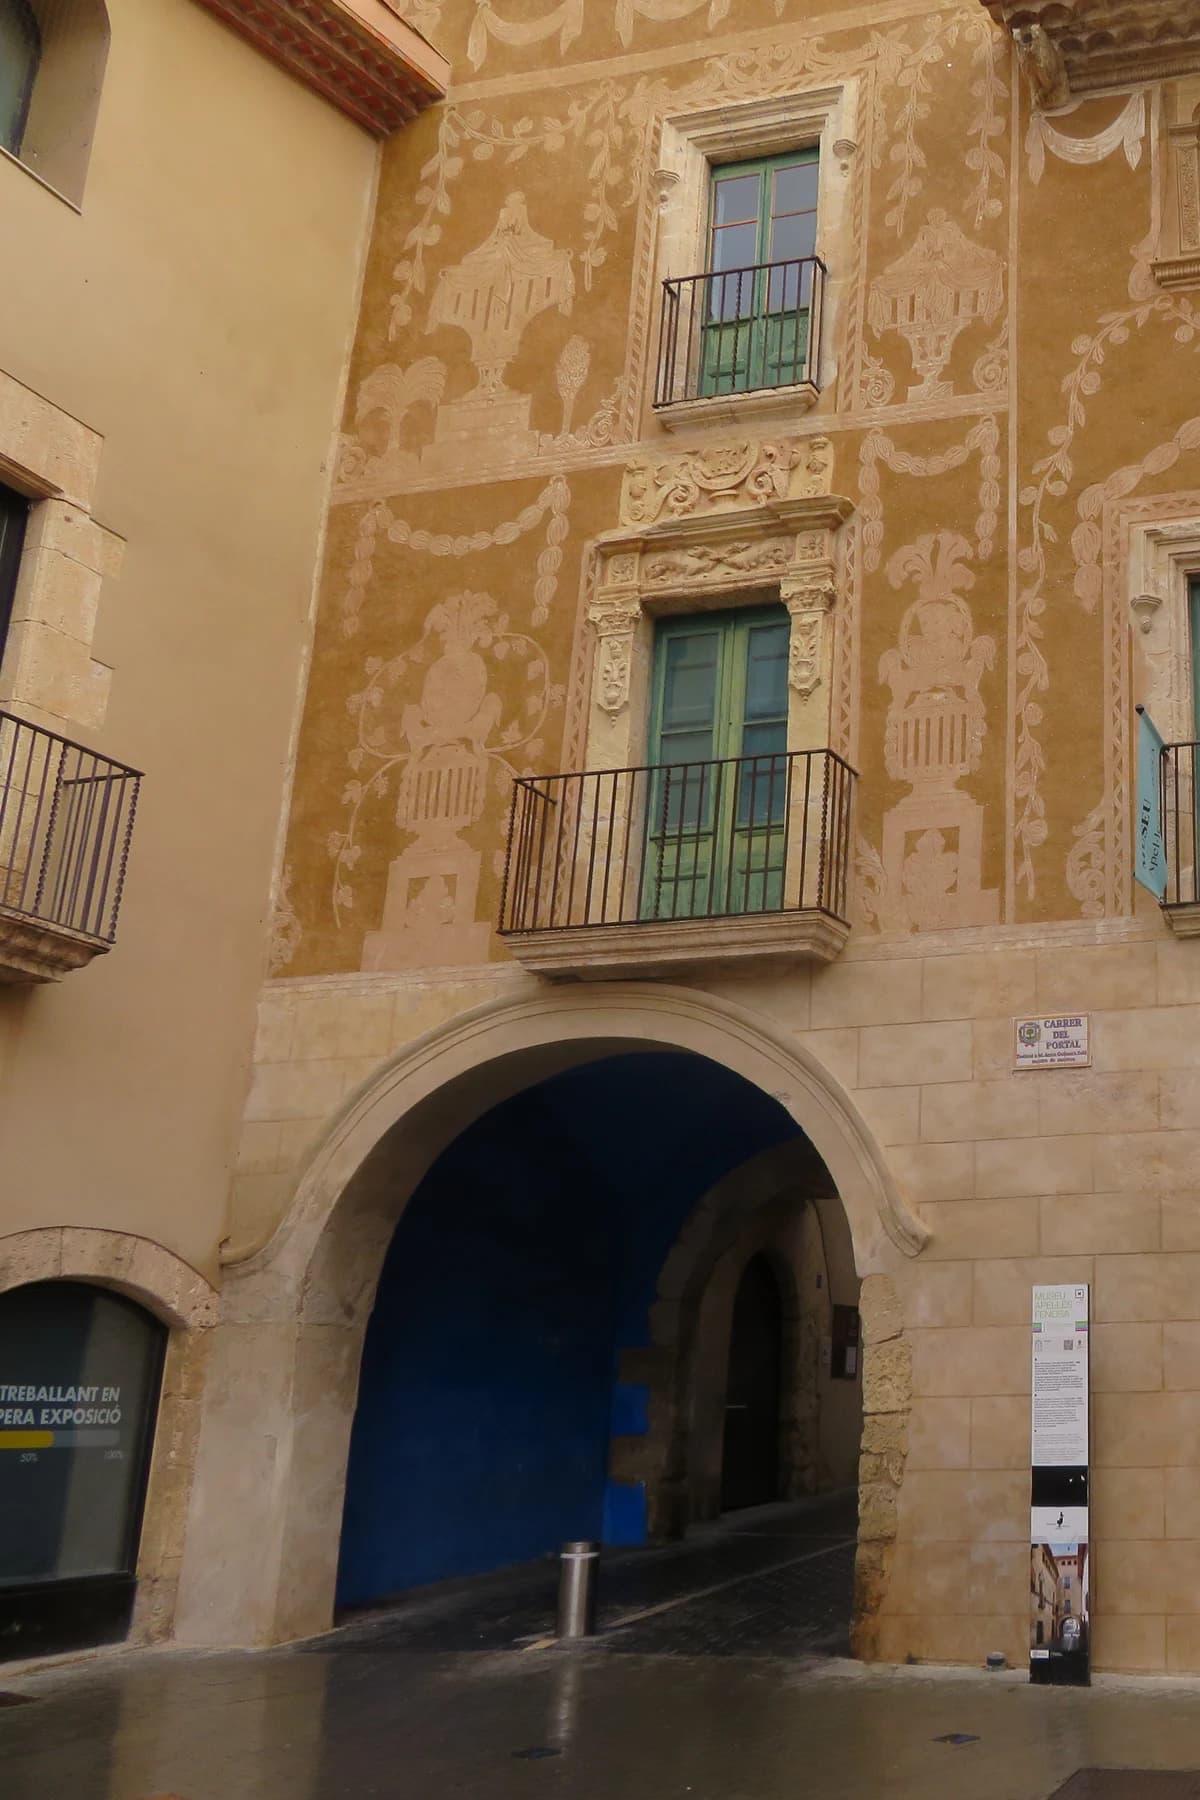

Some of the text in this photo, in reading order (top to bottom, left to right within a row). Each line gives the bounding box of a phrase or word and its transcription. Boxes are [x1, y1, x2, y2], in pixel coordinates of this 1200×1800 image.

[1044, 1018, 1082, 1029] CARRER
[1053, 1031, 1070, 1039] DEL
[1046, 1040, 1081, 1049] PORTAL
[1035, 1291, 1066, 1300] MUSEU
[1035, 1301, 1073, 1309] APELLES
[1035, 1310, 1070, 1318] FENOSA
[0, 1385, 120, 1402] TREBALLANT EN
[41, 1404, 122, 1425] EXPOSICIÓ
[20, 1453, 38, 1463] 50%
